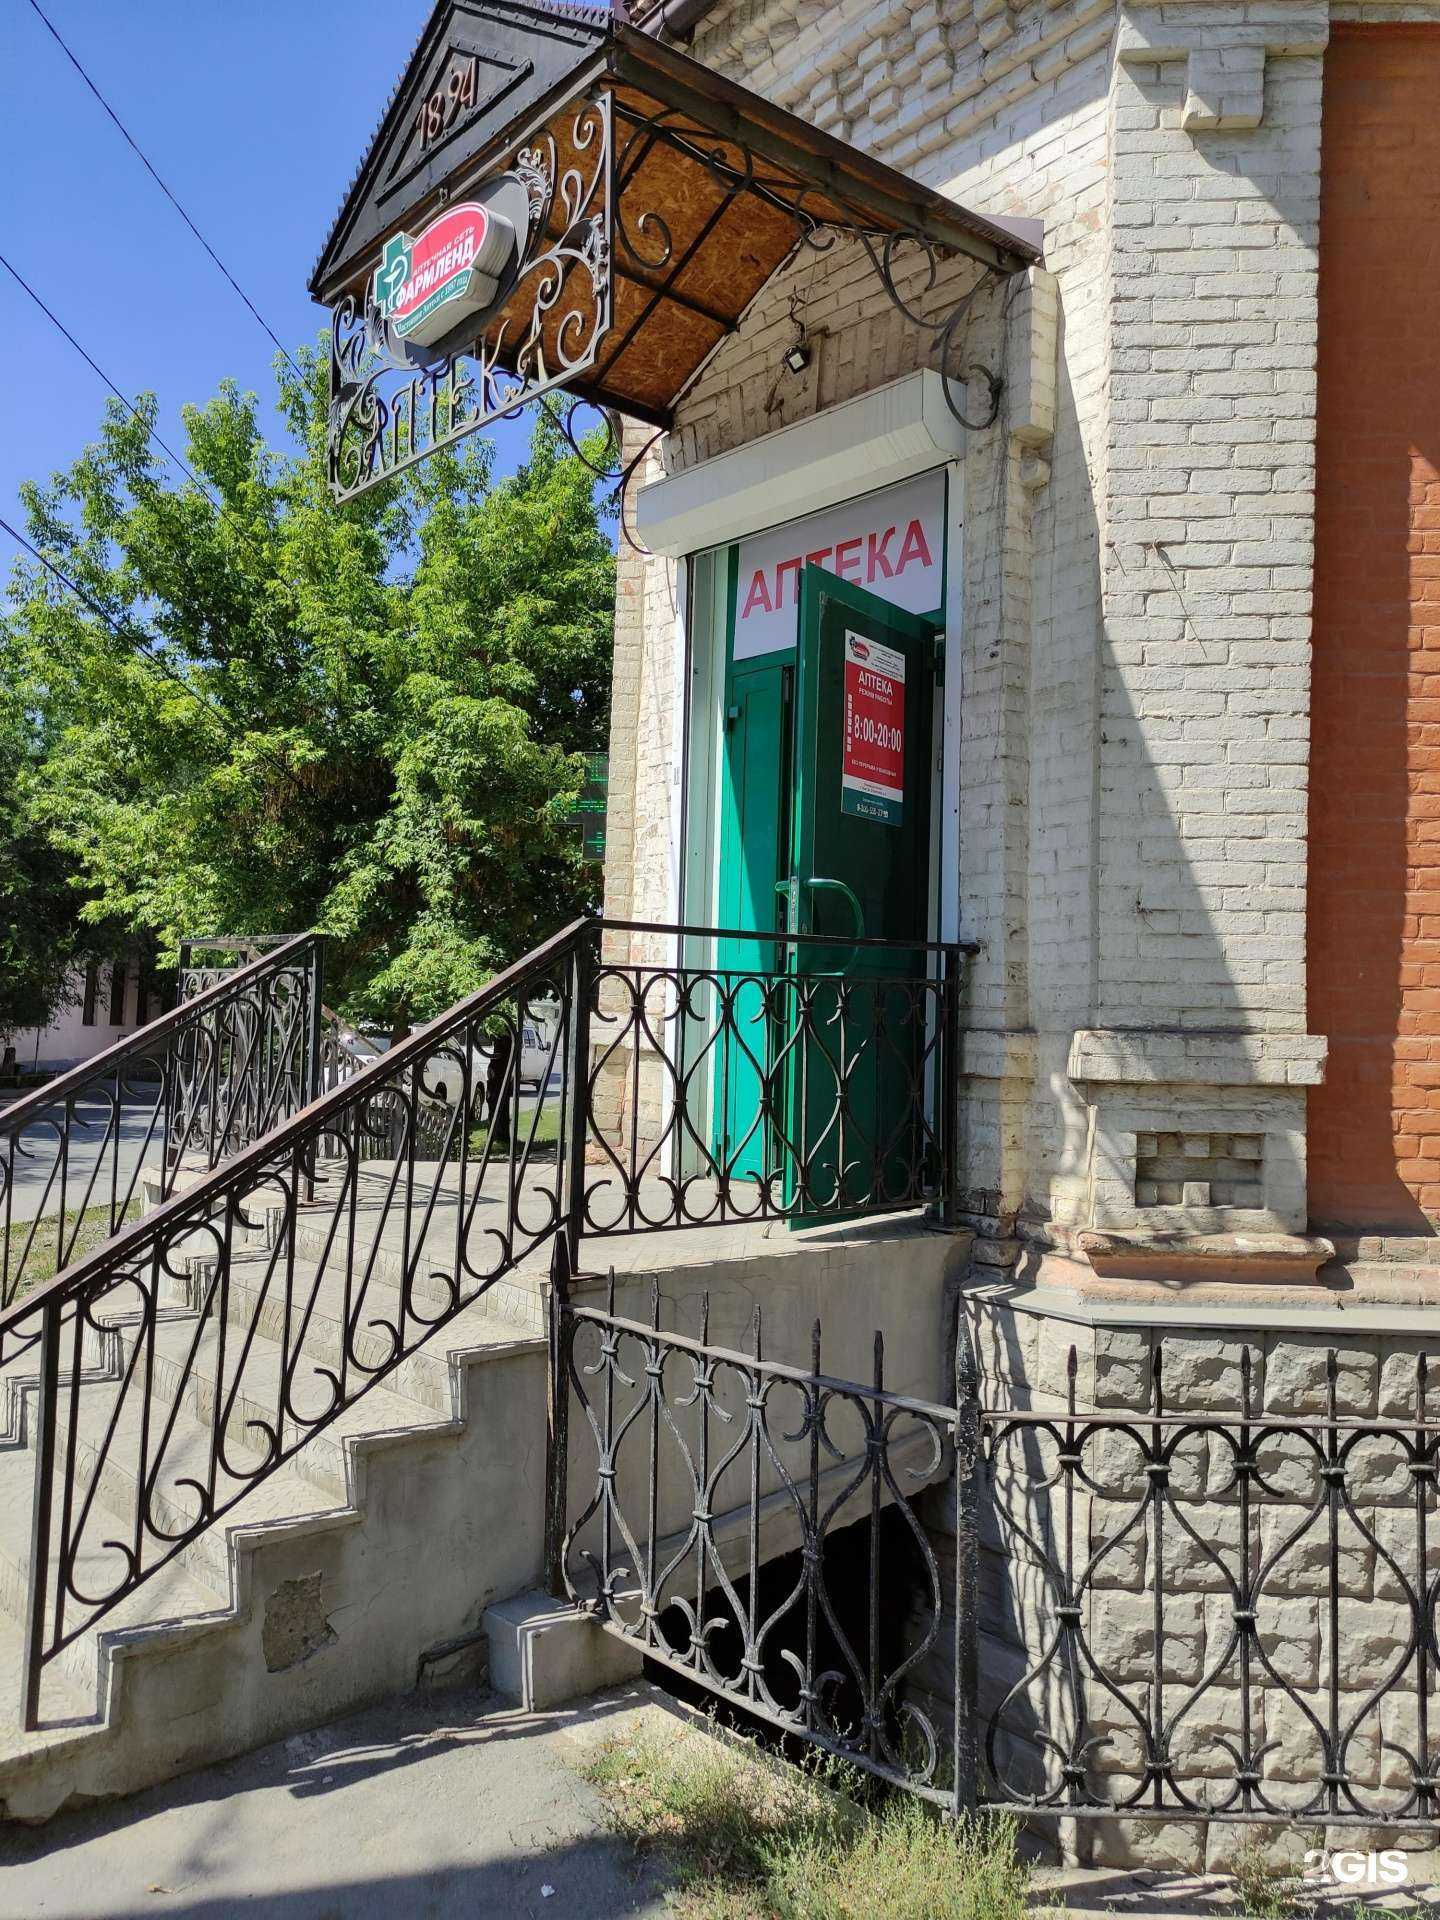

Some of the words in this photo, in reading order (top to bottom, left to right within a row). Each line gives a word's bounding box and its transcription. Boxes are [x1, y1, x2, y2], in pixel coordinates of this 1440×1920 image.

[414, 56, 480, 150] 1894
[396, 234, 475, 308] ФАРМЛЕНД
[413, 242, 452, 276] АПТЕЧНАЯ
[453, 226, 475, 245] СЕТЬ
[336, 304, 549, 494] АПТЕКА
[858, 671, 893, 697] АПТЕКА
[854, 714, 902, 753] 8:00-20:00
